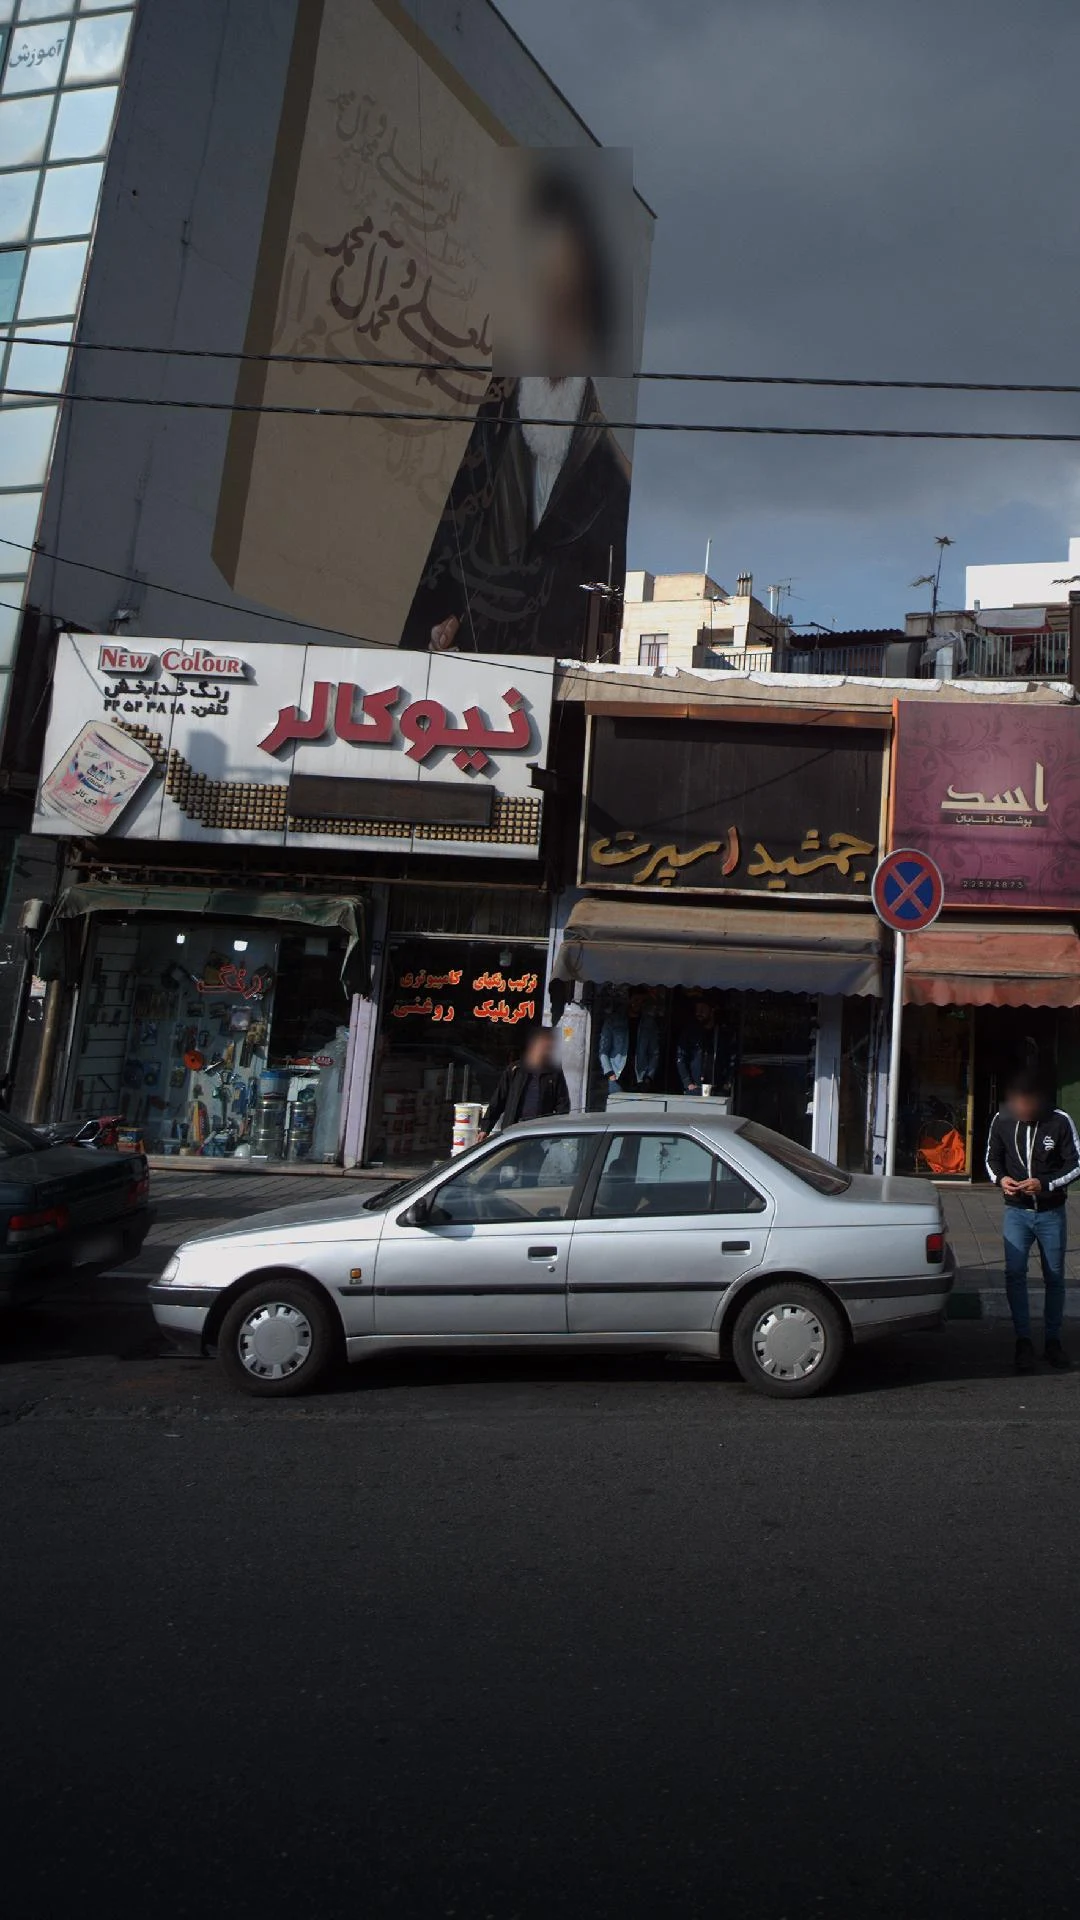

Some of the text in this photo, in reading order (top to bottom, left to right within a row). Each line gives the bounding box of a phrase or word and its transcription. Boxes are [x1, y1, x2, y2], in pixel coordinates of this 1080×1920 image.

[9, 38, 65, 68] آموزش
[324, 216, 374, 267] محمد
[400, 258, 417, 289] و
[357, 294, 400, 342] محمد
[104, 678, 229, 703] رنگ خدابخش
[257, 681, 532, 773] نیوکالر
[994, 815, 1033, 828] پوشاک
[590, 825, 876, 889] جمشید اسپرت
[400, 968, 538, 993] ترکیب رنگهای کامپیوتری
[392, 996, 535, 1024] اکریلیک روغنی
